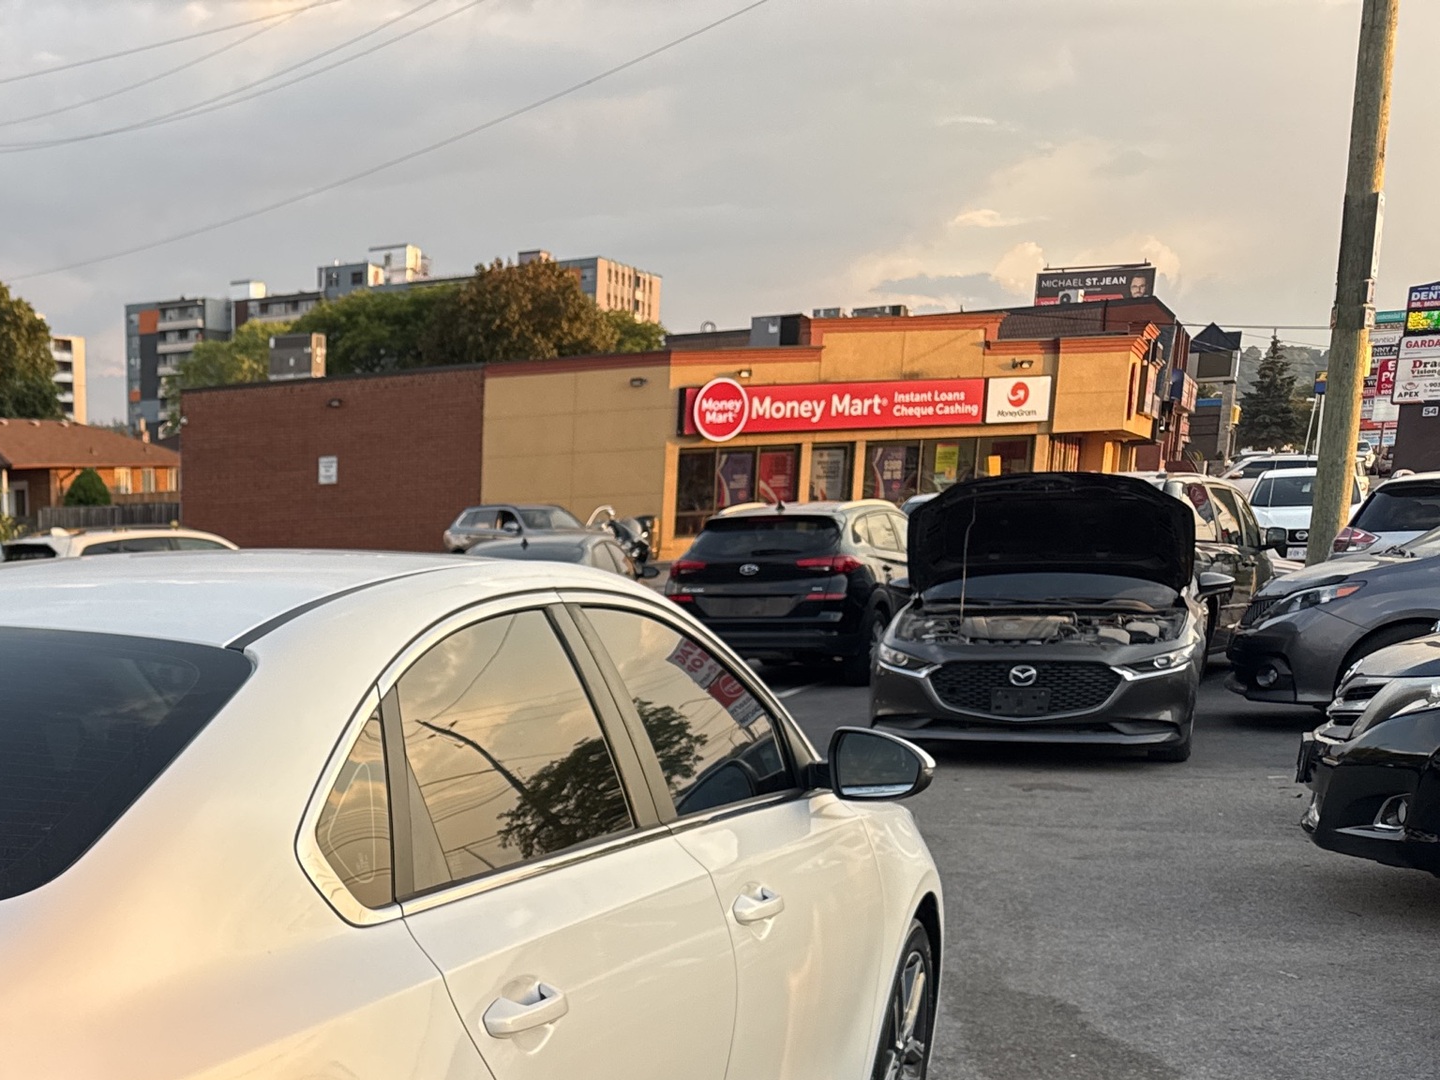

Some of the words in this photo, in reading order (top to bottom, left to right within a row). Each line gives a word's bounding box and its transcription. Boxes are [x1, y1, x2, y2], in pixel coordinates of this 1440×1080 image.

[1042, 278, 1084, 288] MICHAEL
[894, 391, 932, 403] Instant
[934, 390, 965, 401] Loans
[701, 398, 742, 413] Money
[751, 396, 826, 423] Money
[830, 393, 882, 417] Mart
[893, 404, 934, 418] Cheque
[935, 402, 978, 417] Cashing
[705, 411, 734, 424] Mart
[997, 409, 1037, 418] MoneyGram
